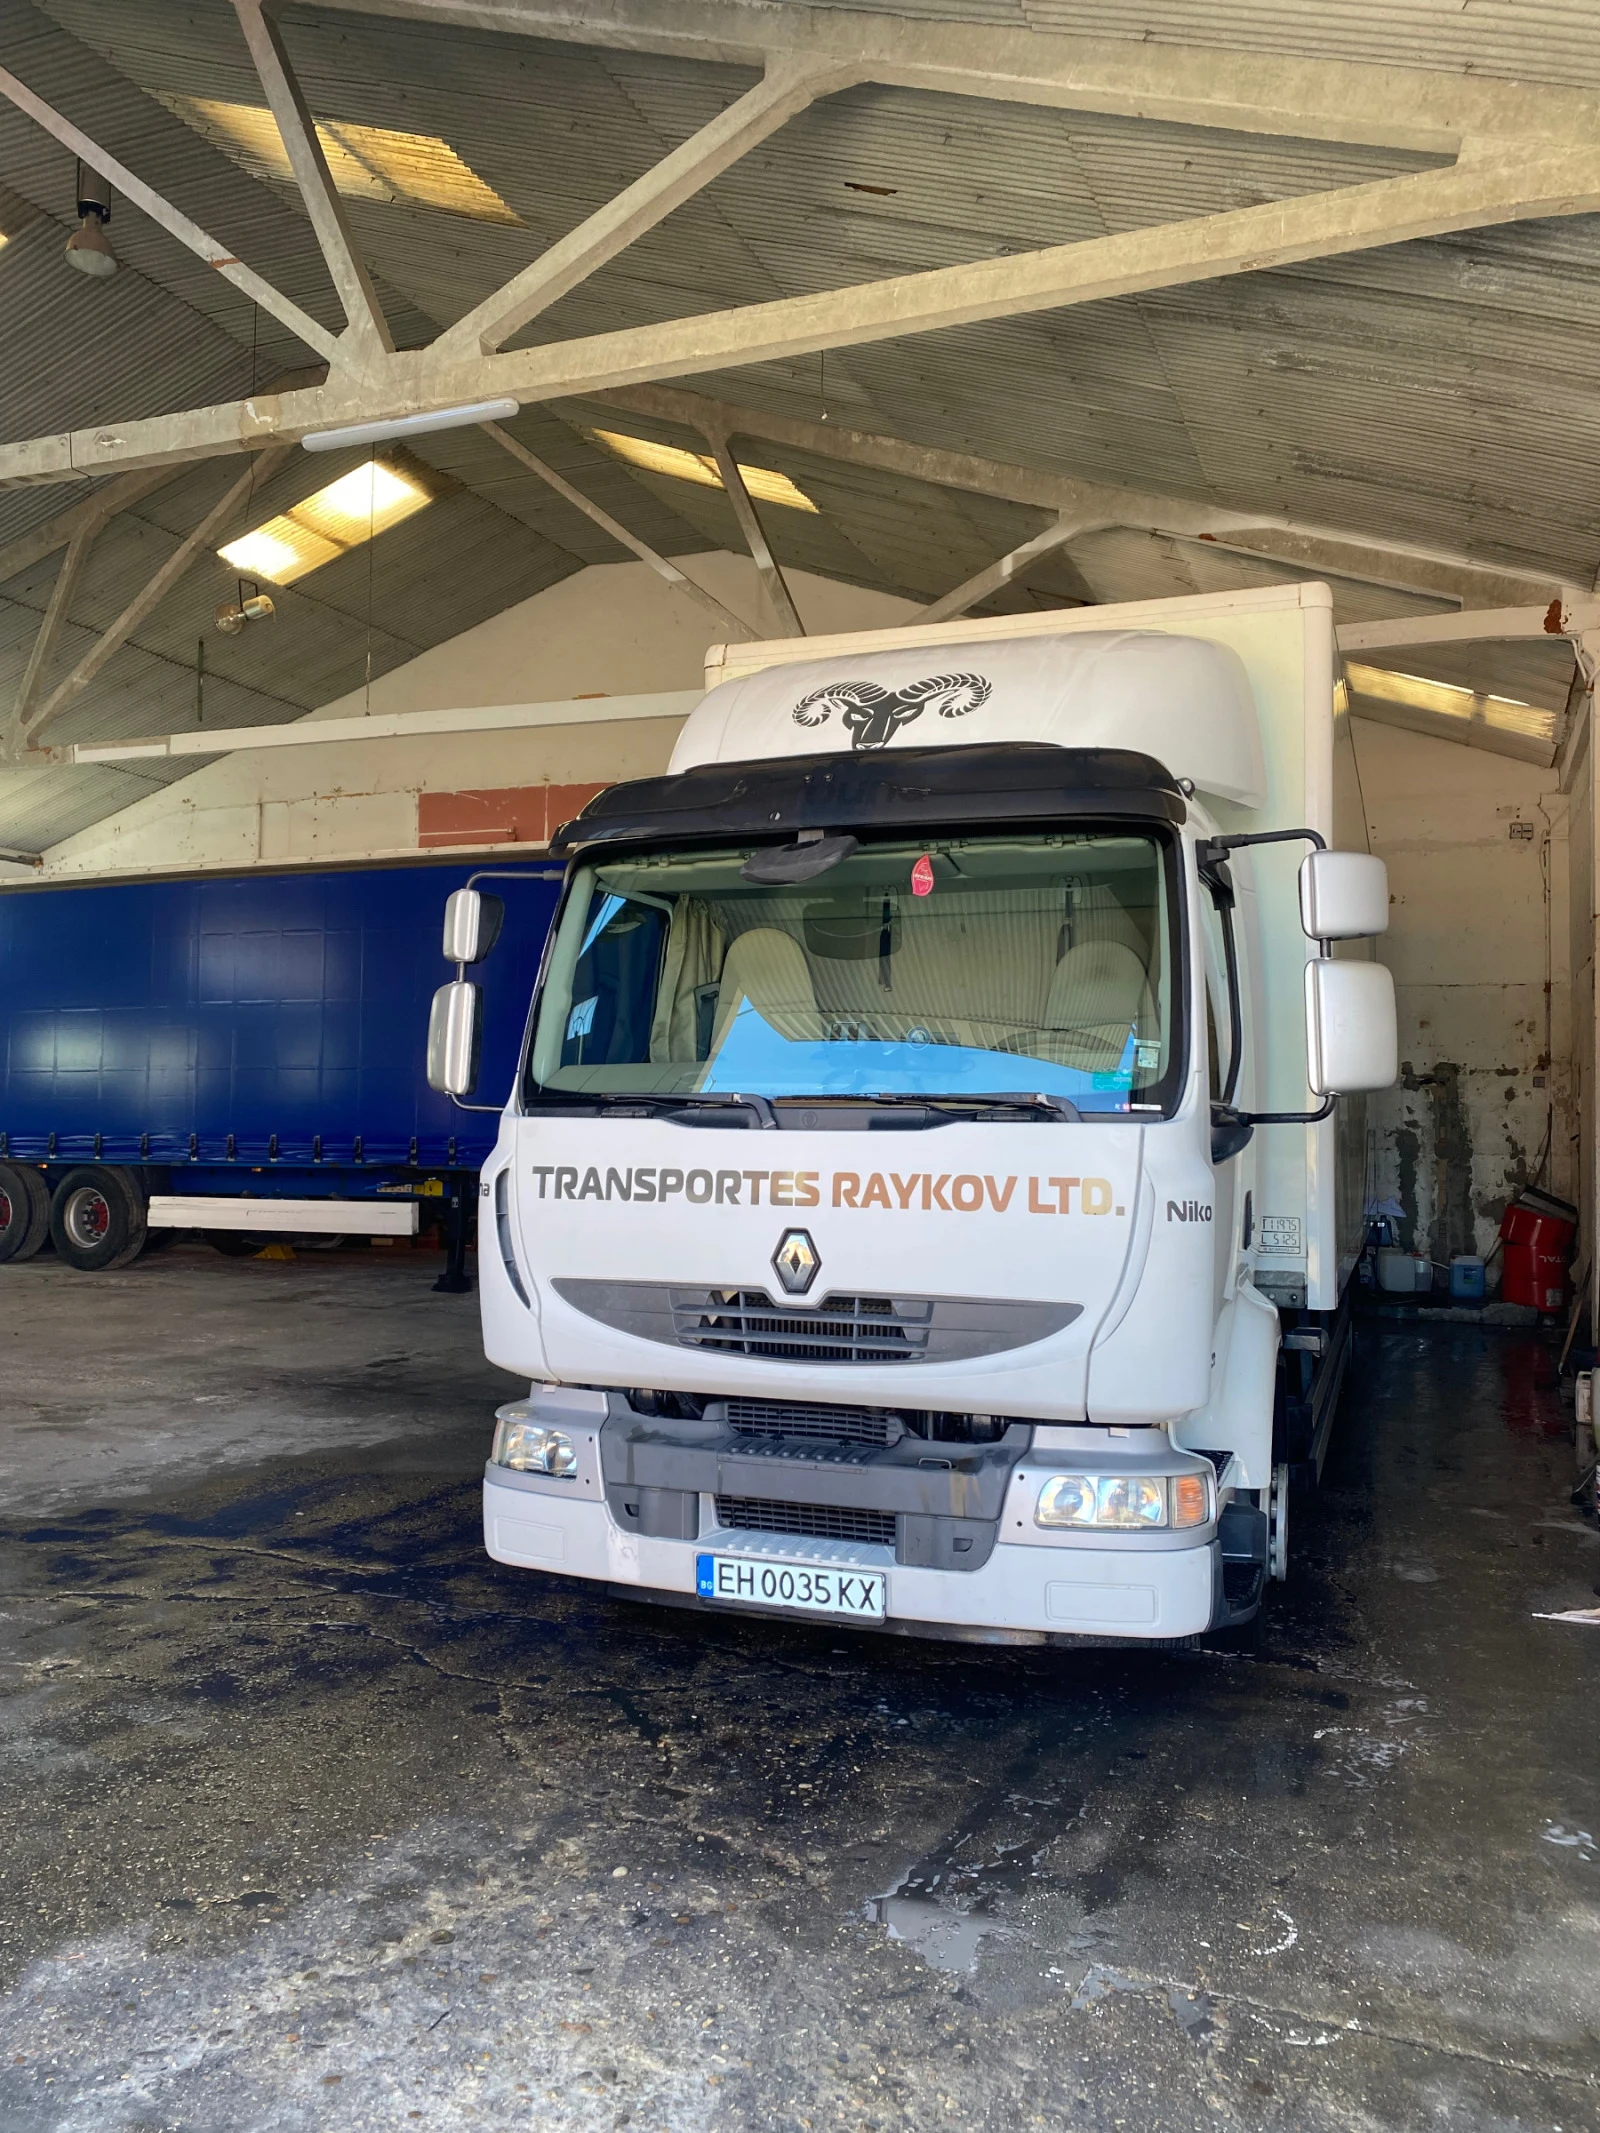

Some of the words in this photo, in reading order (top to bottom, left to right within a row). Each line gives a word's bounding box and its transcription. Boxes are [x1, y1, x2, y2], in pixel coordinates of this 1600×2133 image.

[531, 1165, 819, 1207] TRANSPORTES
[832, 1171, 1017, 1213] RAYKOV
[1028, 1176, 1126, 1216] LTD.
[1166, 1200, 1212, 1222] Niko
[700, 1580, 713, 1591] BG
[718, 1562, 755, 1596] EH
[761, 1568, 832, 1605] 0035
[838, 1576, 876, 1611] KX
